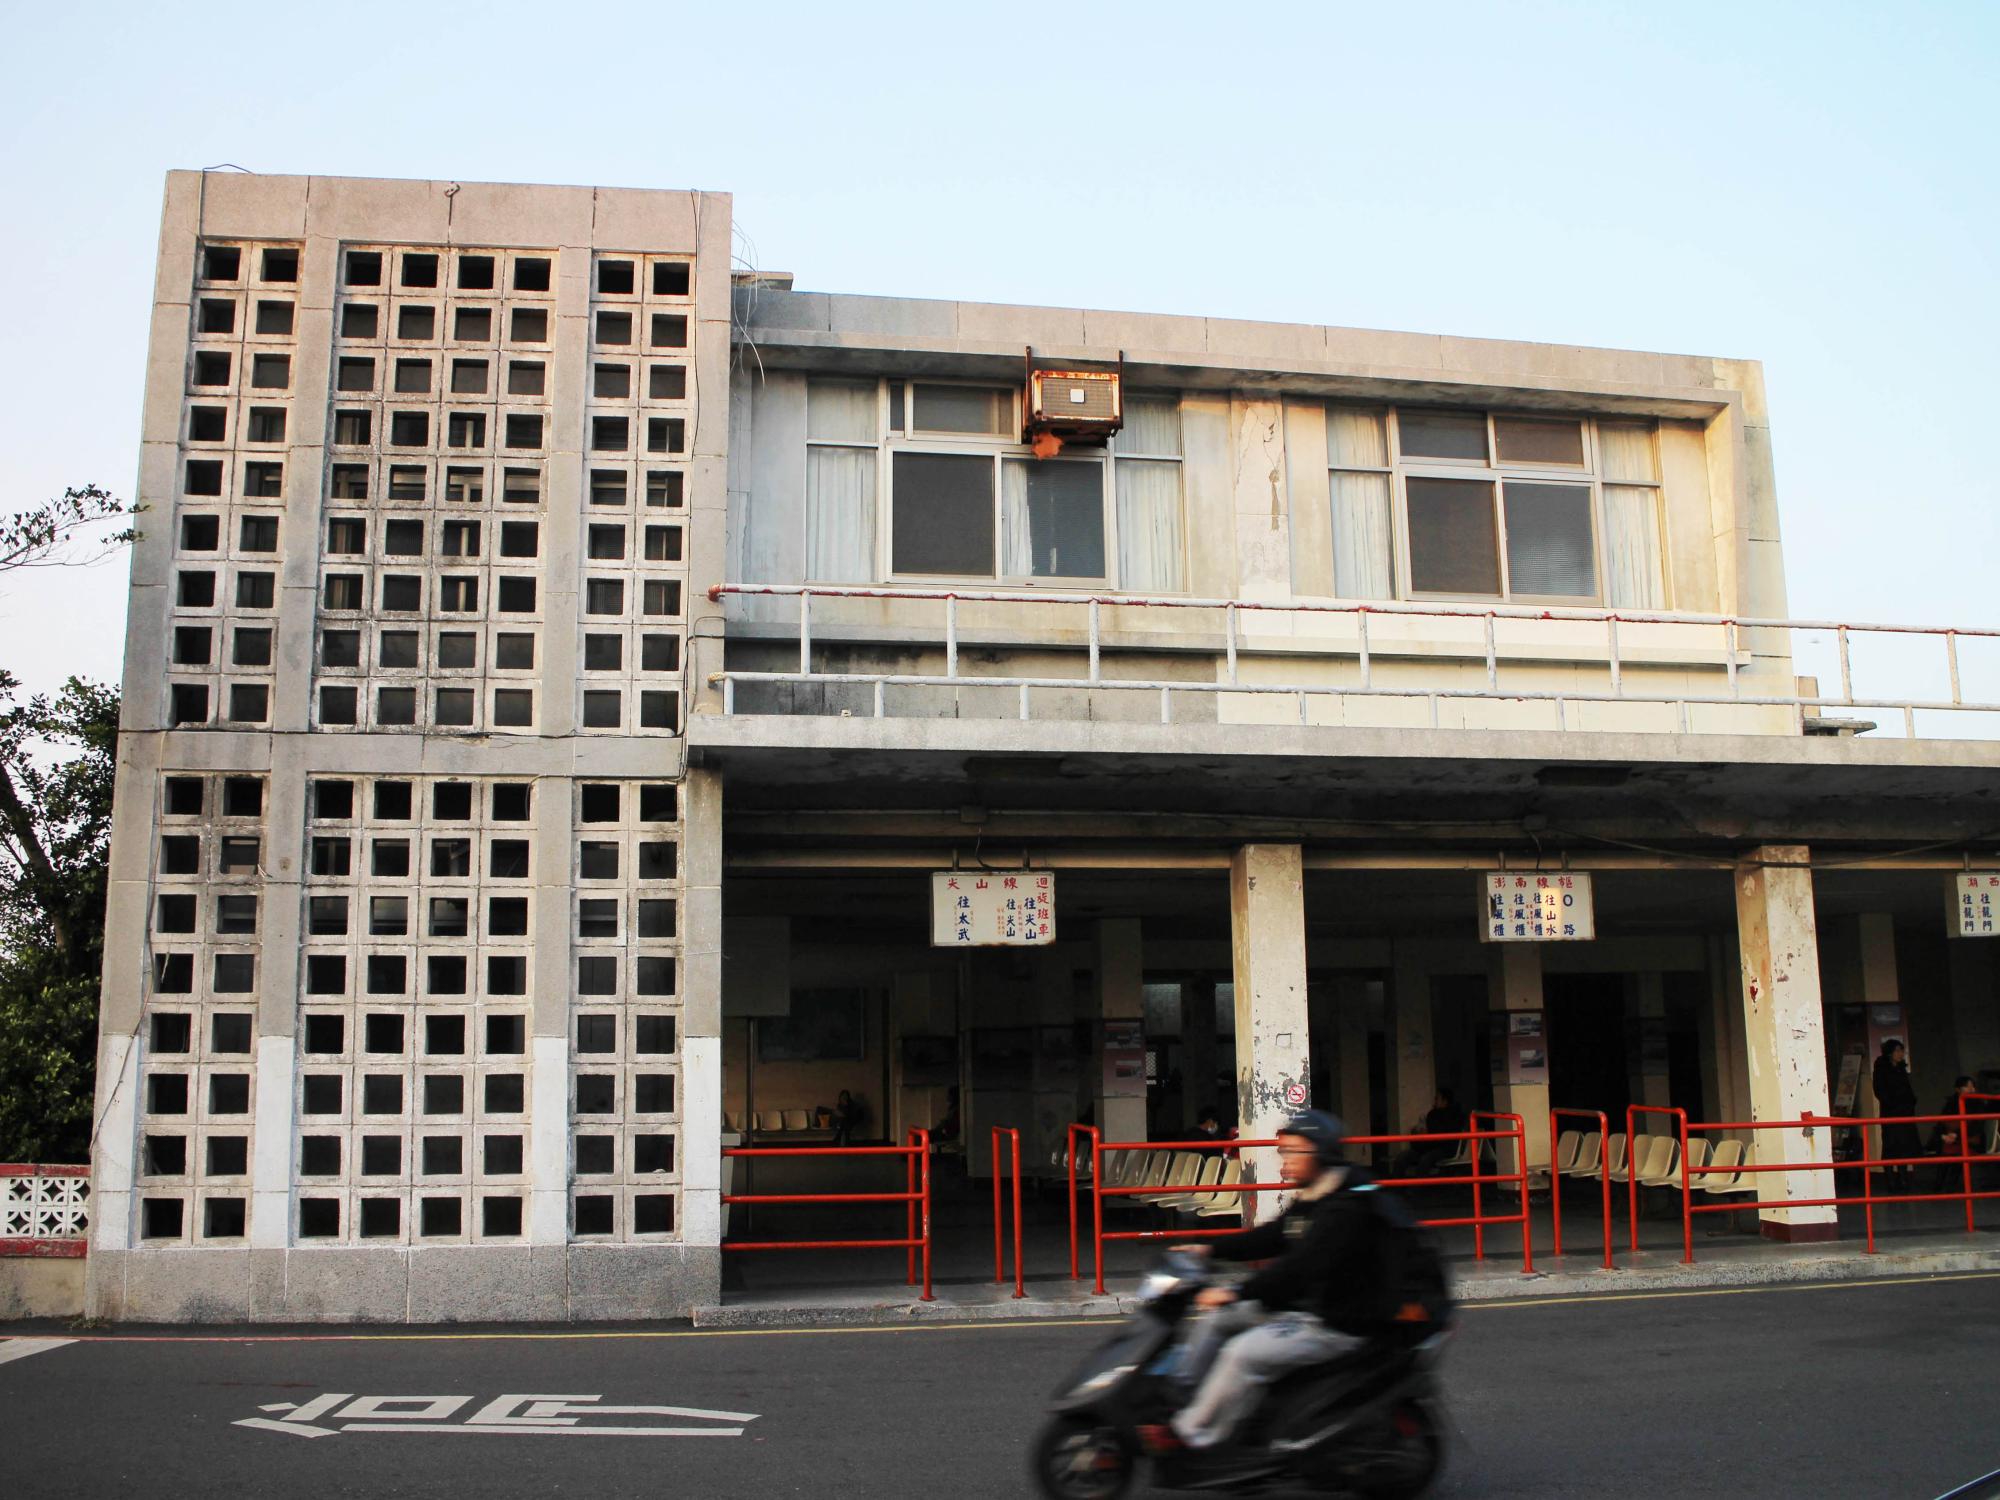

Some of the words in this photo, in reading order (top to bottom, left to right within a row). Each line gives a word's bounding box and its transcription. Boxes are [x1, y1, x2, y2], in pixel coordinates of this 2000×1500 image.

[947, 877, 1018, 889] 尖山線
[1494, 876, 1549, 889] 澎南線
[1968, 876, 2000, 888] 湖西
[957, 896, 970, 941] 往太武
[1006, 899, 1016, 938] 往尖山
[1024, 897, 1037, 940] 往尖山
[1514, 893, 1525, 936] 往風櫃
[1533, 892, 1543, 936] 往風櫃
[1545, 895, 1557, 936] 往山水
[1962, 894, 1974, 932] 往龍門
[1981, 893, 1992, 932] 往龍門
[231, 1394, 762, 1438] 停
